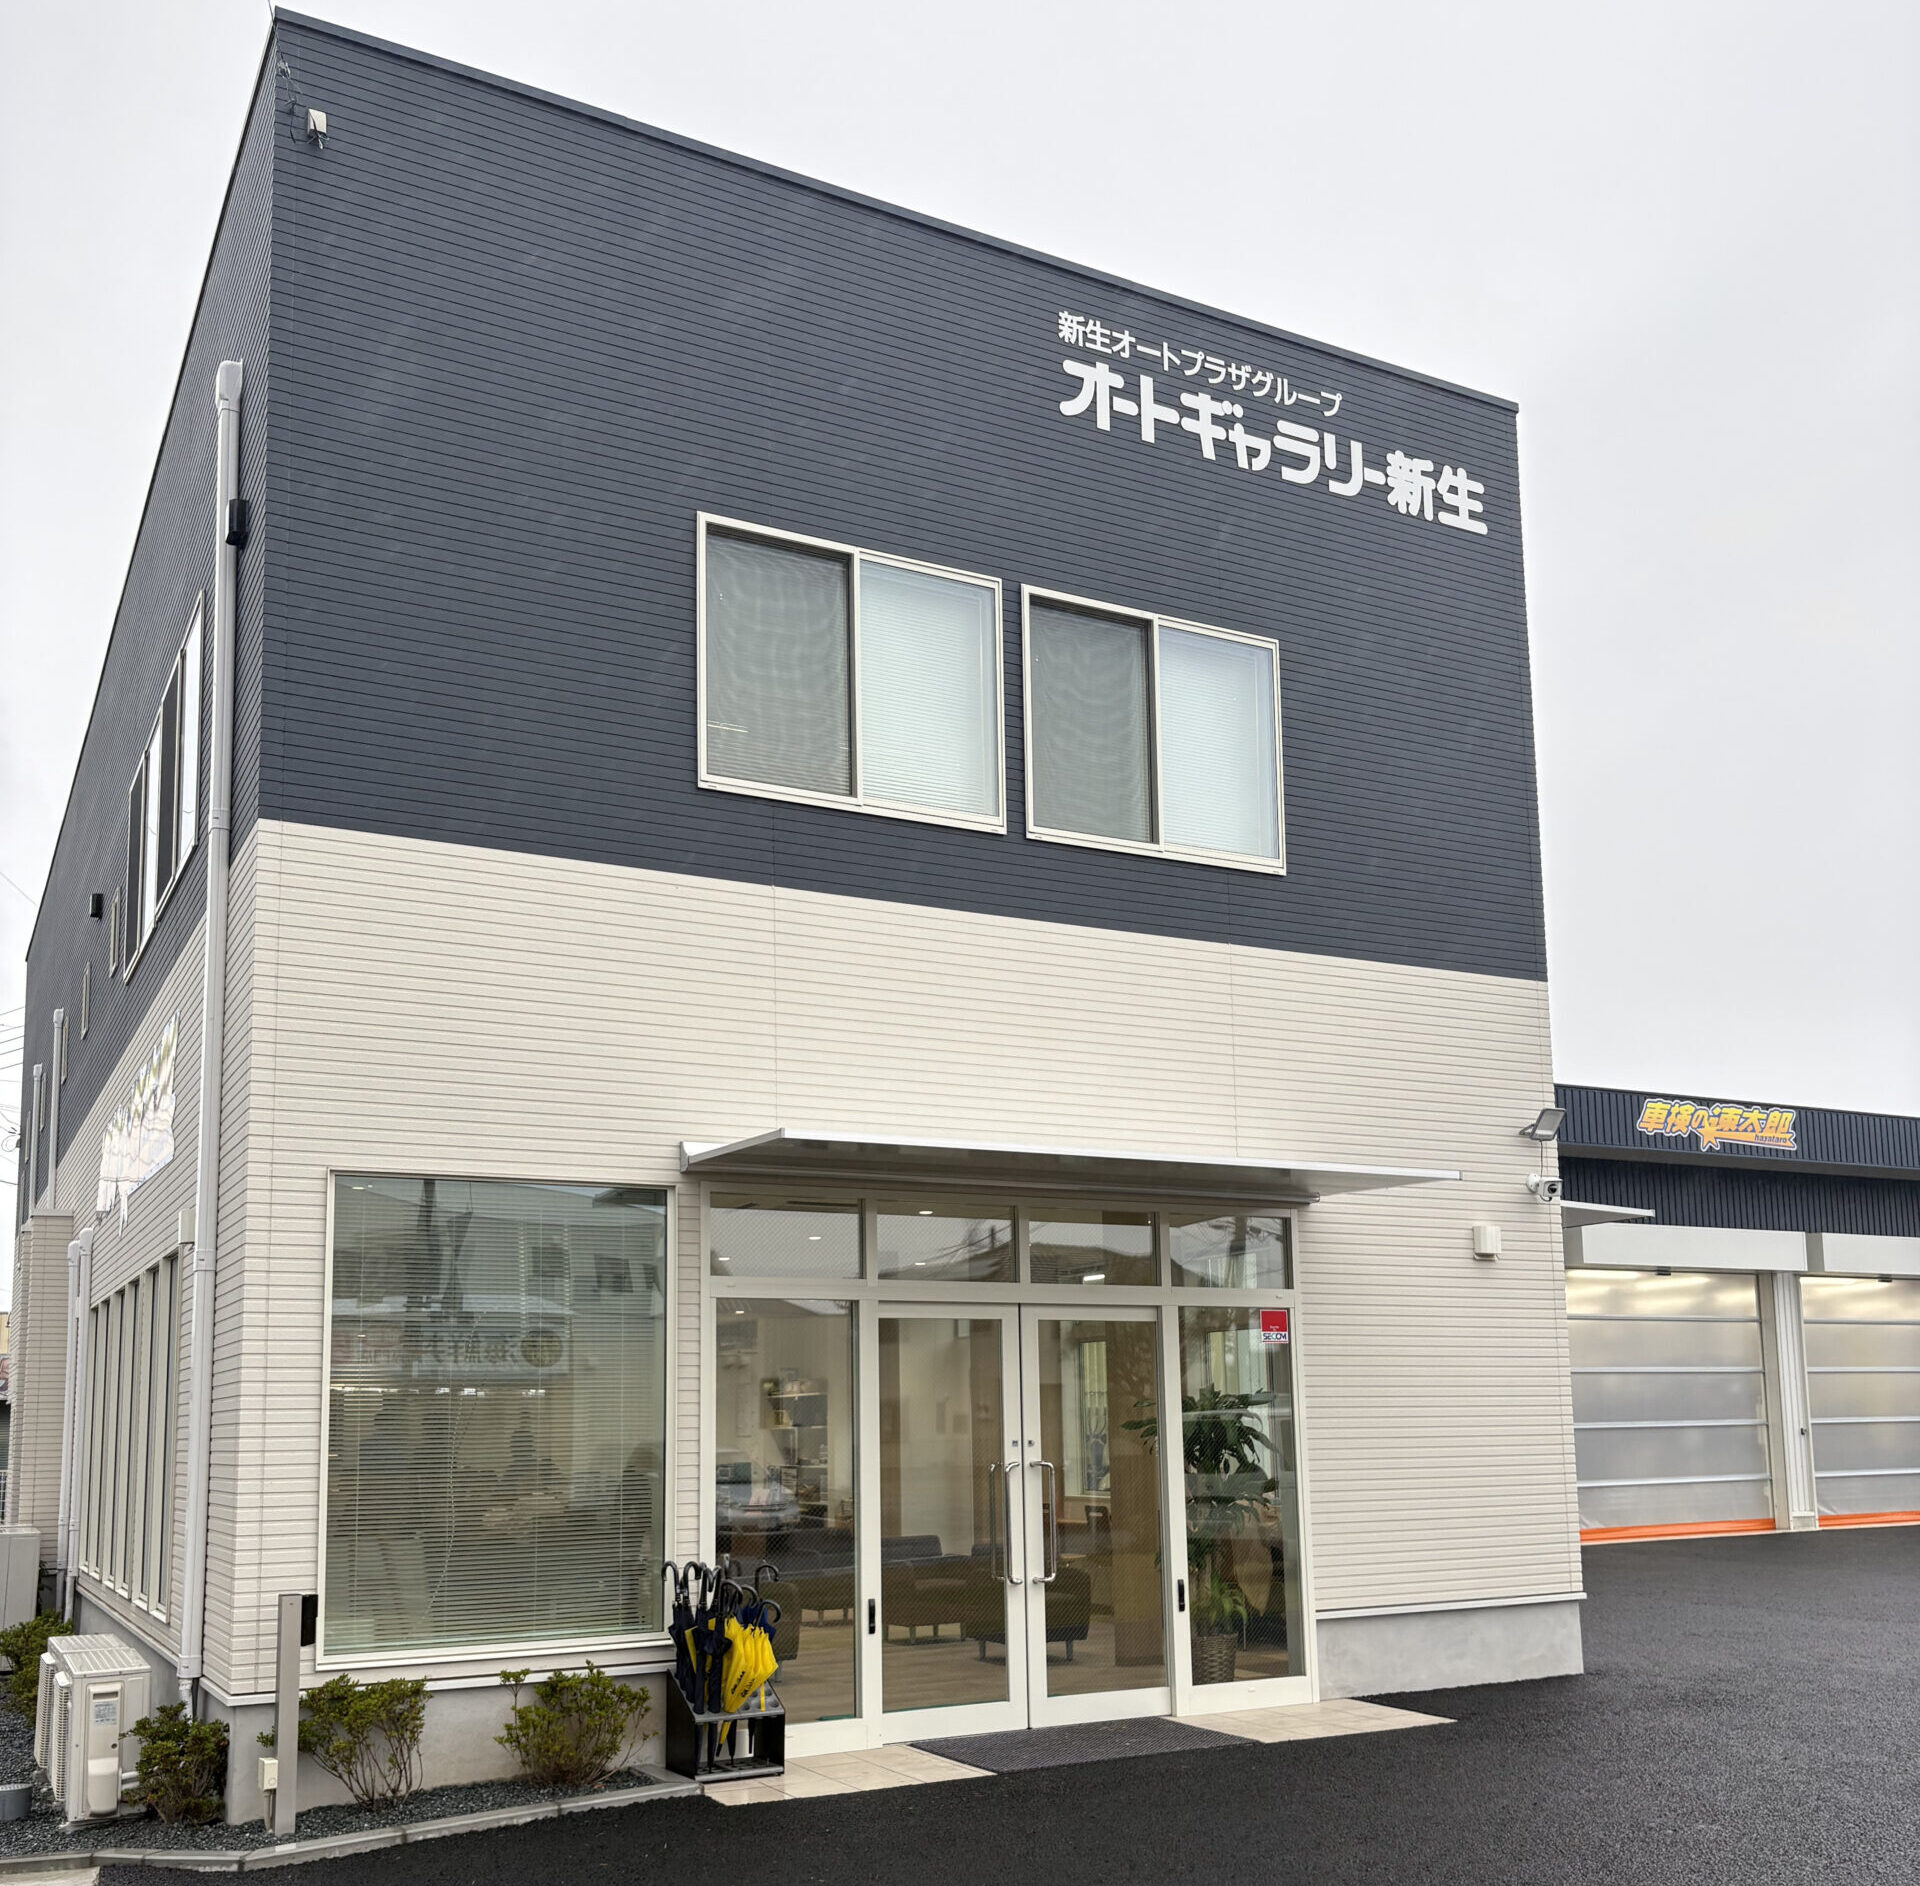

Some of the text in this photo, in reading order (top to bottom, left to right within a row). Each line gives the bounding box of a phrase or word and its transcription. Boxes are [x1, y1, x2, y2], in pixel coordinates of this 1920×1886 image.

[1058, 310, 1343, 417] 新生オートプラザグループ
[1059, 358, 1489, 536] オートギャラリー新生
[1262, 1332, 1287, 1340] SECOM
